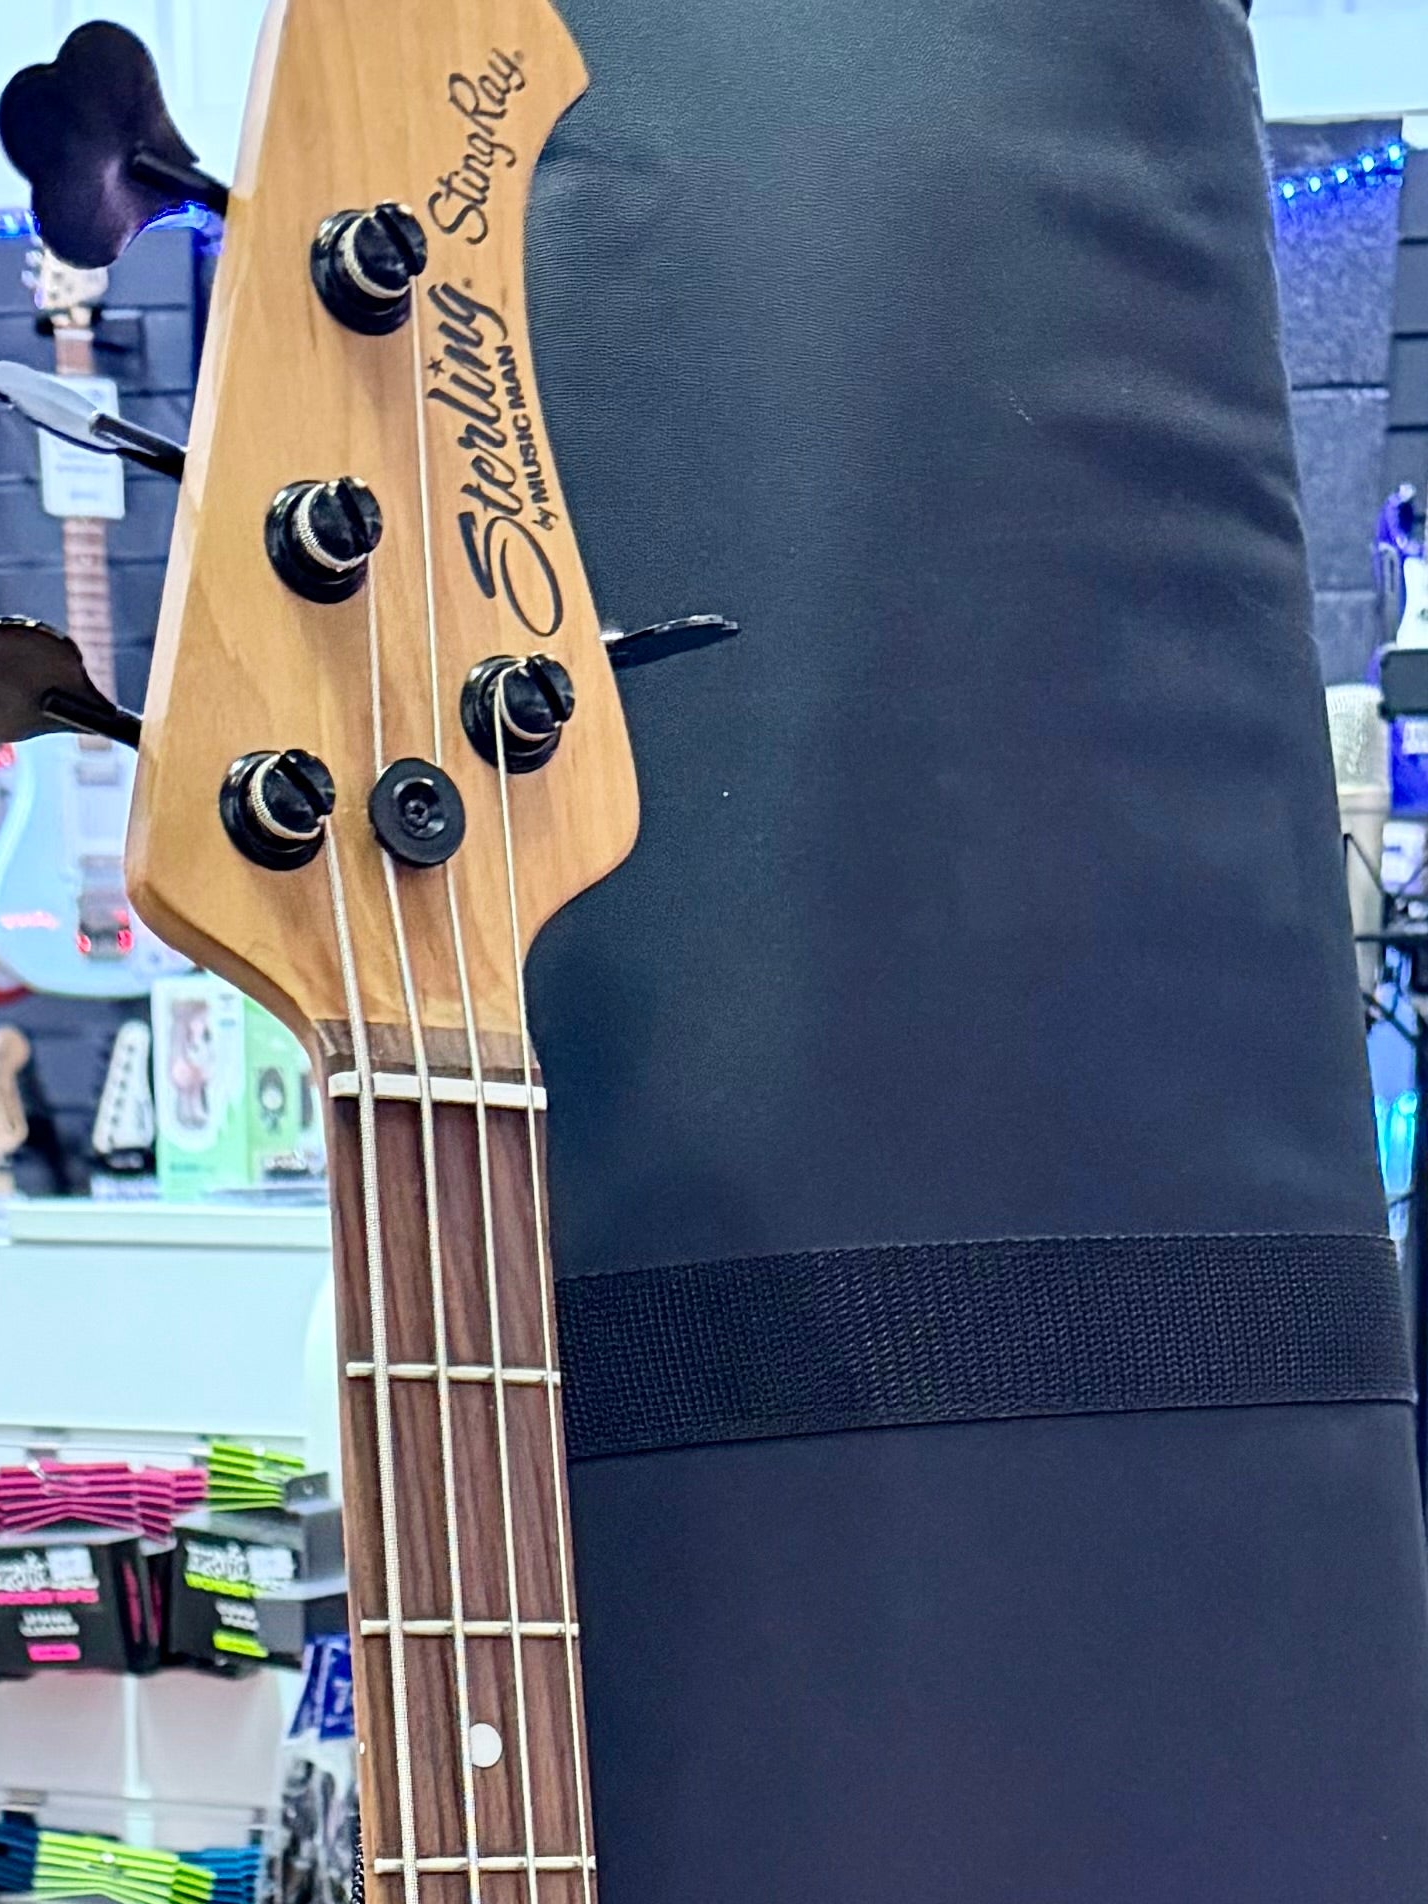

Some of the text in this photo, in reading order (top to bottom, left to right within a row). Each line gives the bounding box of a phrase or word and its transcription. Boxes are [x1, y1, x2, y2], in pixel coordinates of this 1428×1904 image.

[428, 47, 523, 245] StingRay
[426, 281, 563, 637] Sterling
[496, 345, 560, 532] by MUSIC MAN
